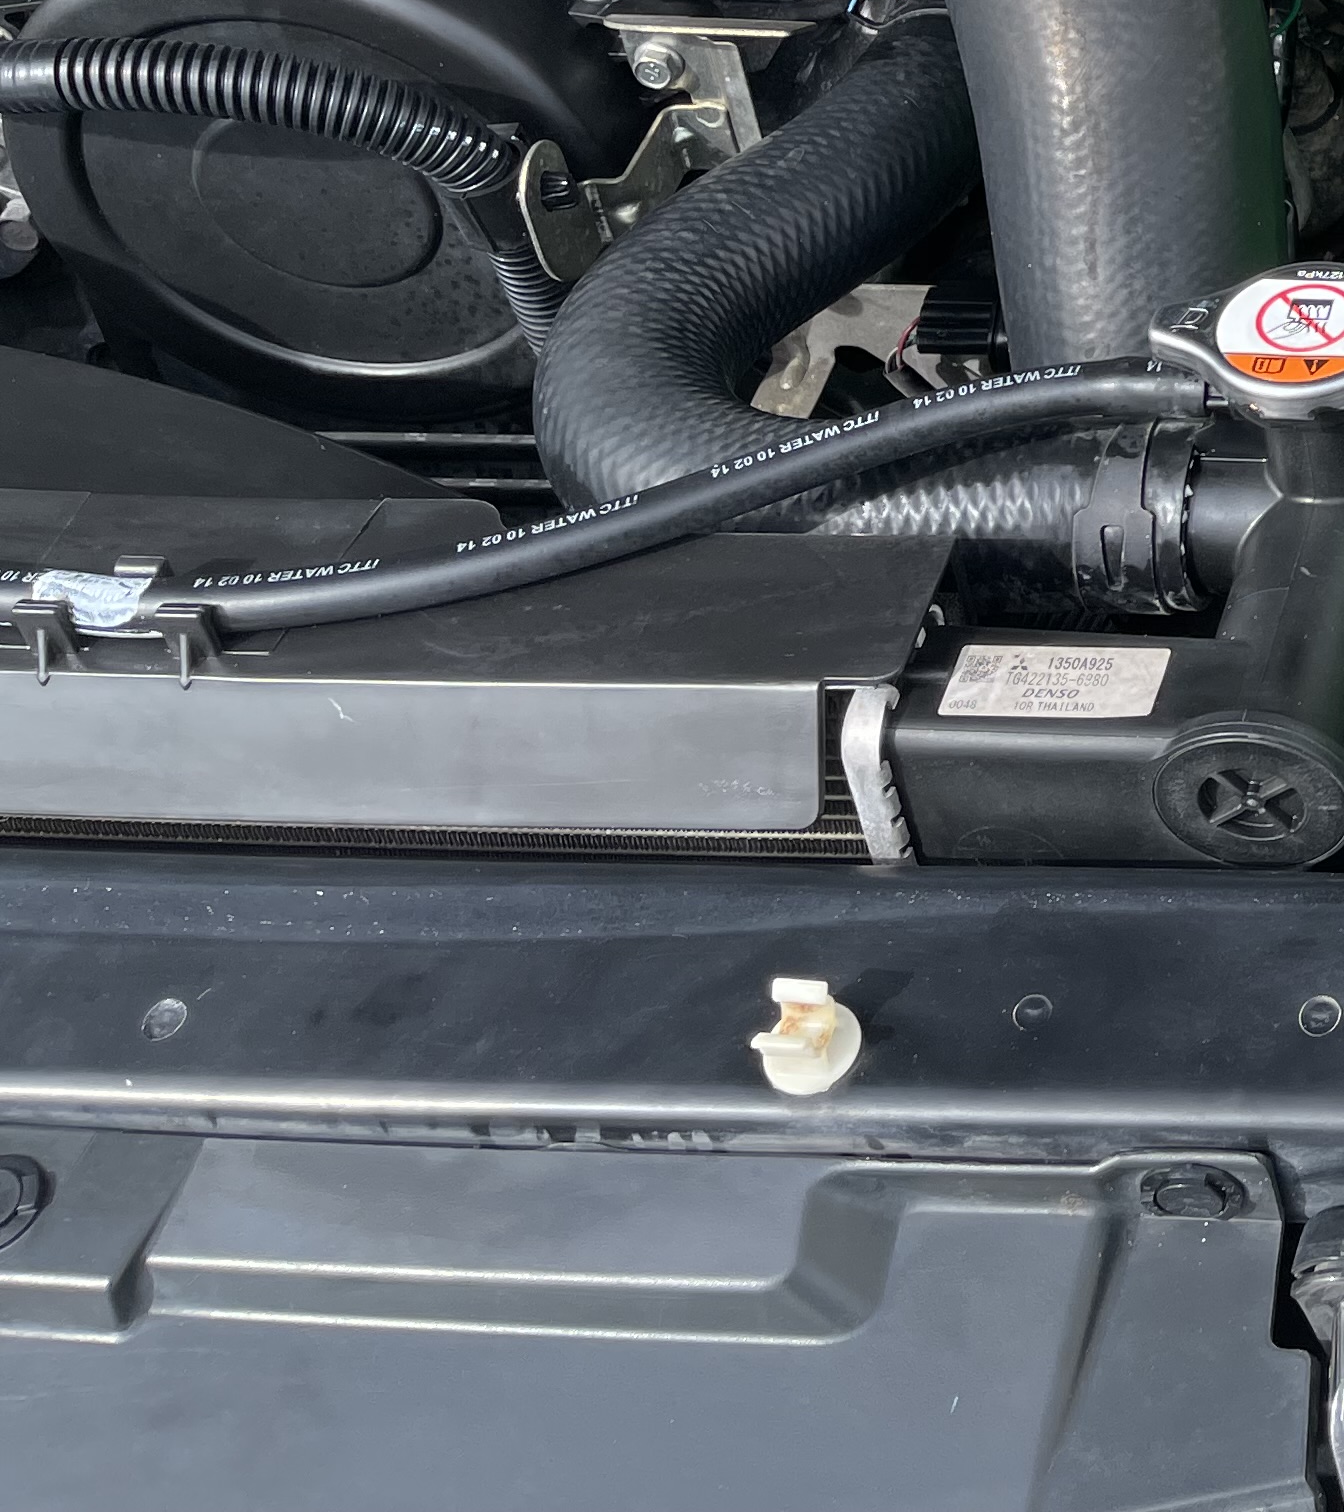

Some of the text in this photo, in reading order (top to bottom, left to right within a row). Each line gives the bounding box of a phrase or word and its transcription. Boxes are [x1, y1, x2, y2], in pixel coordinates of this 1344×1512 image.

[1297, 269, 1344, 281] 127kPa
[981, 371, 1040, 391] WATER
[936, 388, 954, 402] 02
[959, 382, 977, 396] 10
[912, 396, 932, 409] 14
[778, 425, 840, 454] WATER
[756, 448, 775, 462] 10
[734, 455, 753, 470] 02
[711, 464, 729, 479] 14
[531, 508, 597, 535] WATER
[482, 534, 502, 547] 02
[506, 527, 526, 541] 10
[456, 539, 476, 553] 14
[217, 575, 239, 586] 02
[242, 573, 262, 585] 10
[267, 565, 334, 582] WATER
[193, 577, 213, 588] 14
[1048, 657, 1114, 671] 1350A925
[1022, 689, 1080, 699] DENSO
[1037, 701, 1095, 712] THAILAND
